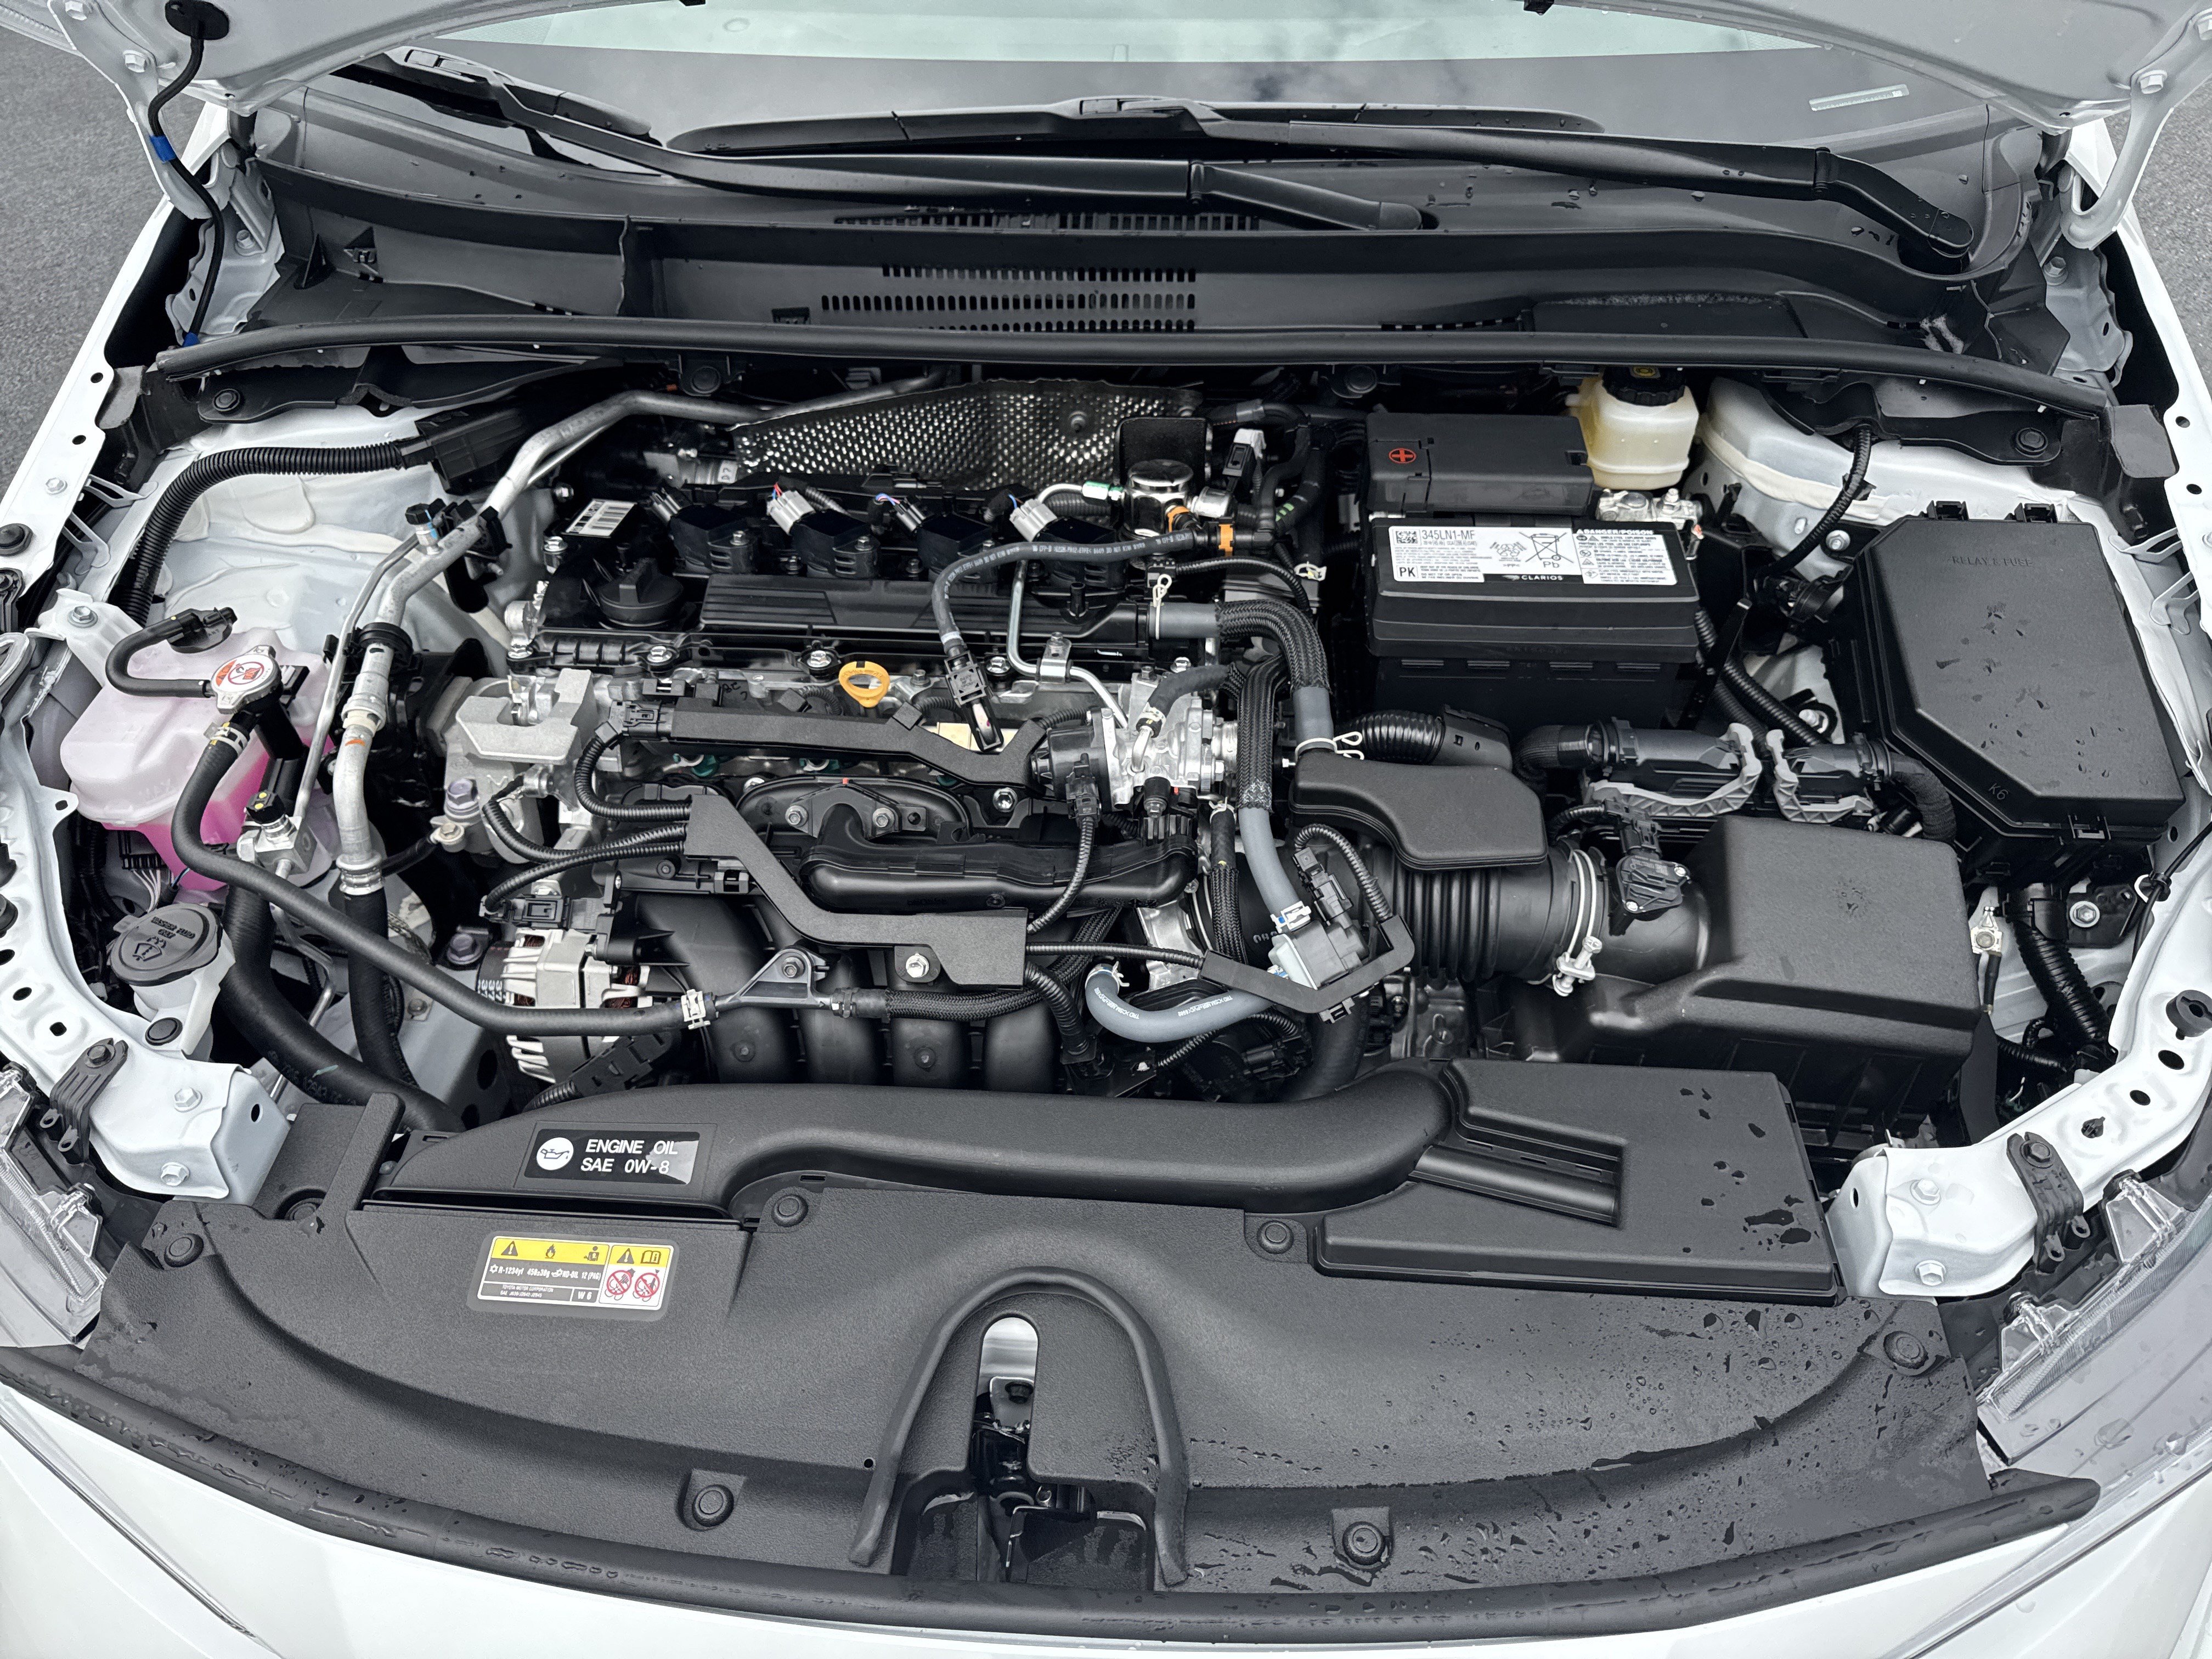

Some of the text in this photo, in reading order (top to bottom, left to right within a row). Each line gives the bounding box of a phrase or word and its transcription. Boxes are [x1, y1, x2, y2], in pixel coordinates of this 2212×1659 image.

[1421, 529, 1475, 540] 345LN1-MF
[1951, 556, 1988, 566] RELAY
[2003, 558, 2033, 567] FUSE
[1399, 567, 1416, 577] PK
[1988, 783, 2009, 800] K6
[585, 1139, 679, 1155] ENGINE OIL
[580, 1158, 669, 1174] SAE 0W-8
